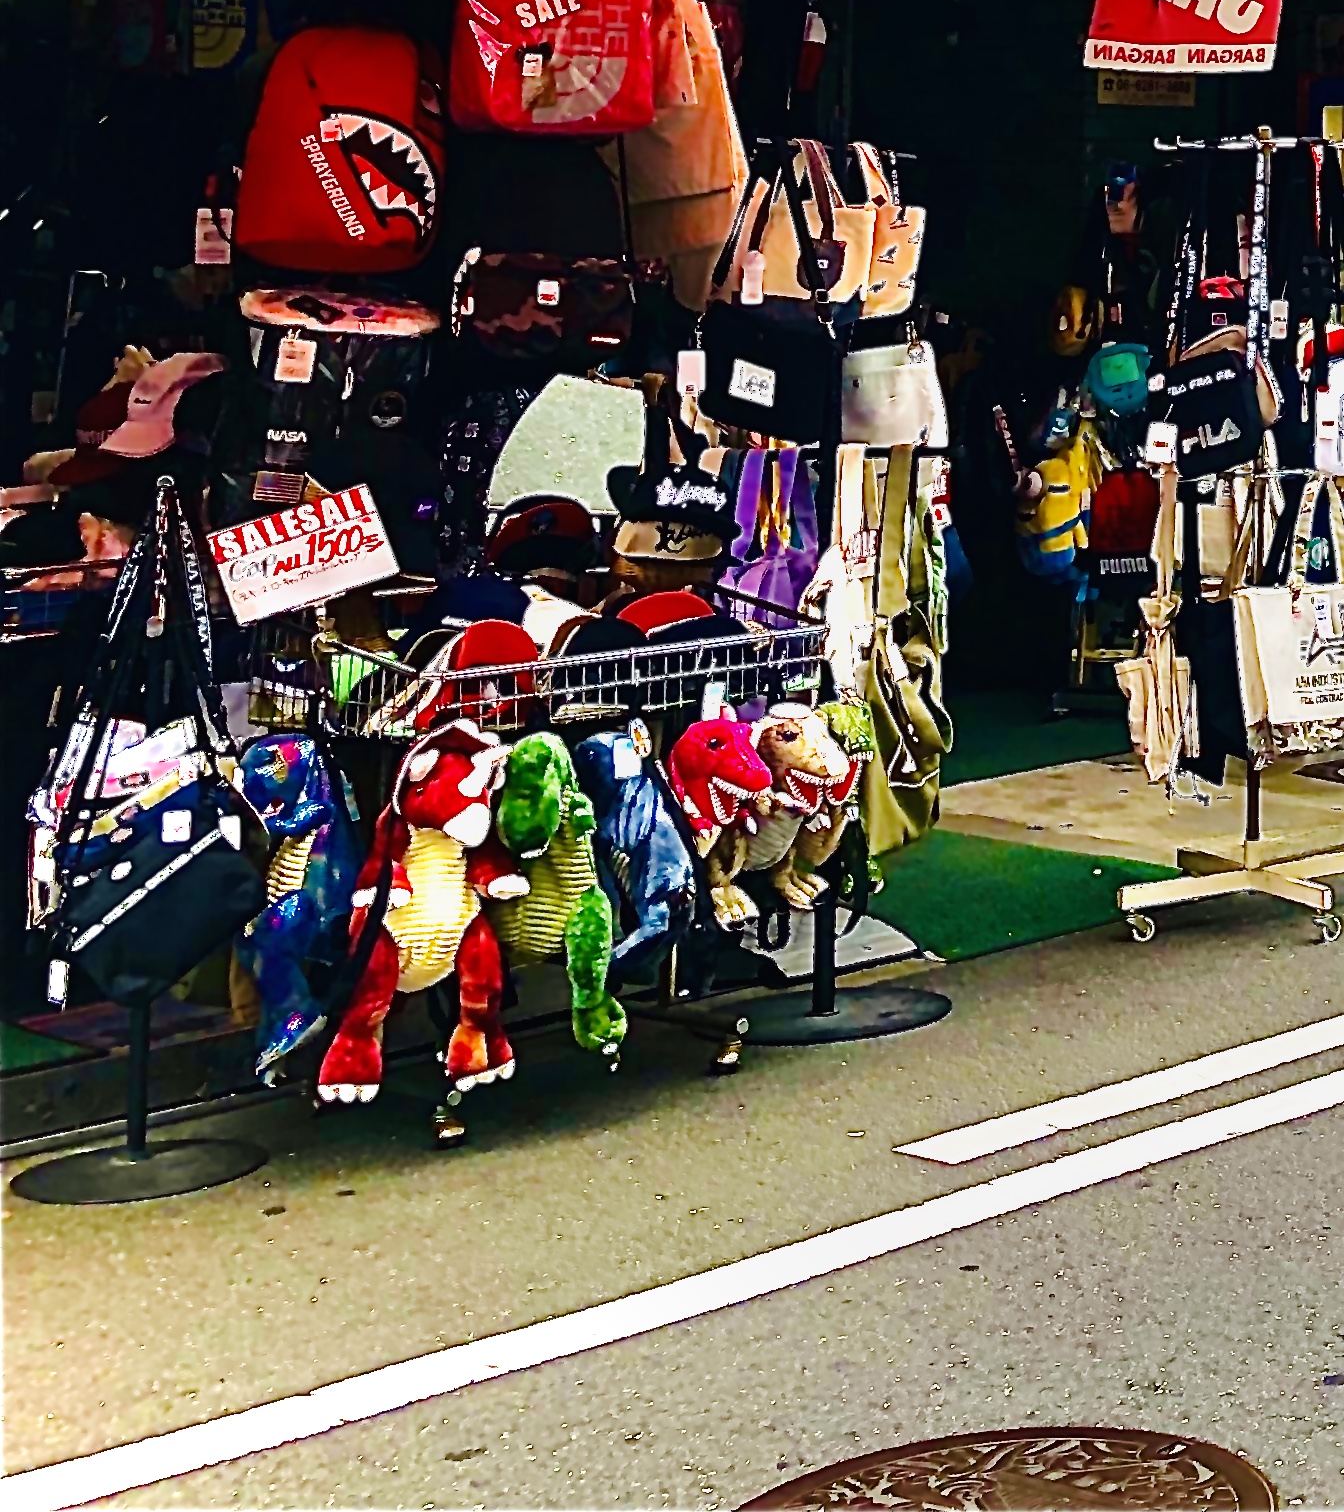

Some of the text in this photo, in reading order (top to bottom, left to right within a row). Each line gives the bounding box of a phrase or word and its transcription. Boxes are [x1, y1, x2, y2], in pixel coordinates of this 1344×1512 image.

[300, 134, 365, 238] SPRAYGROUND
[267, 429, 307, 444] NASA
[1100, 557, 1148, 575] PUMA
